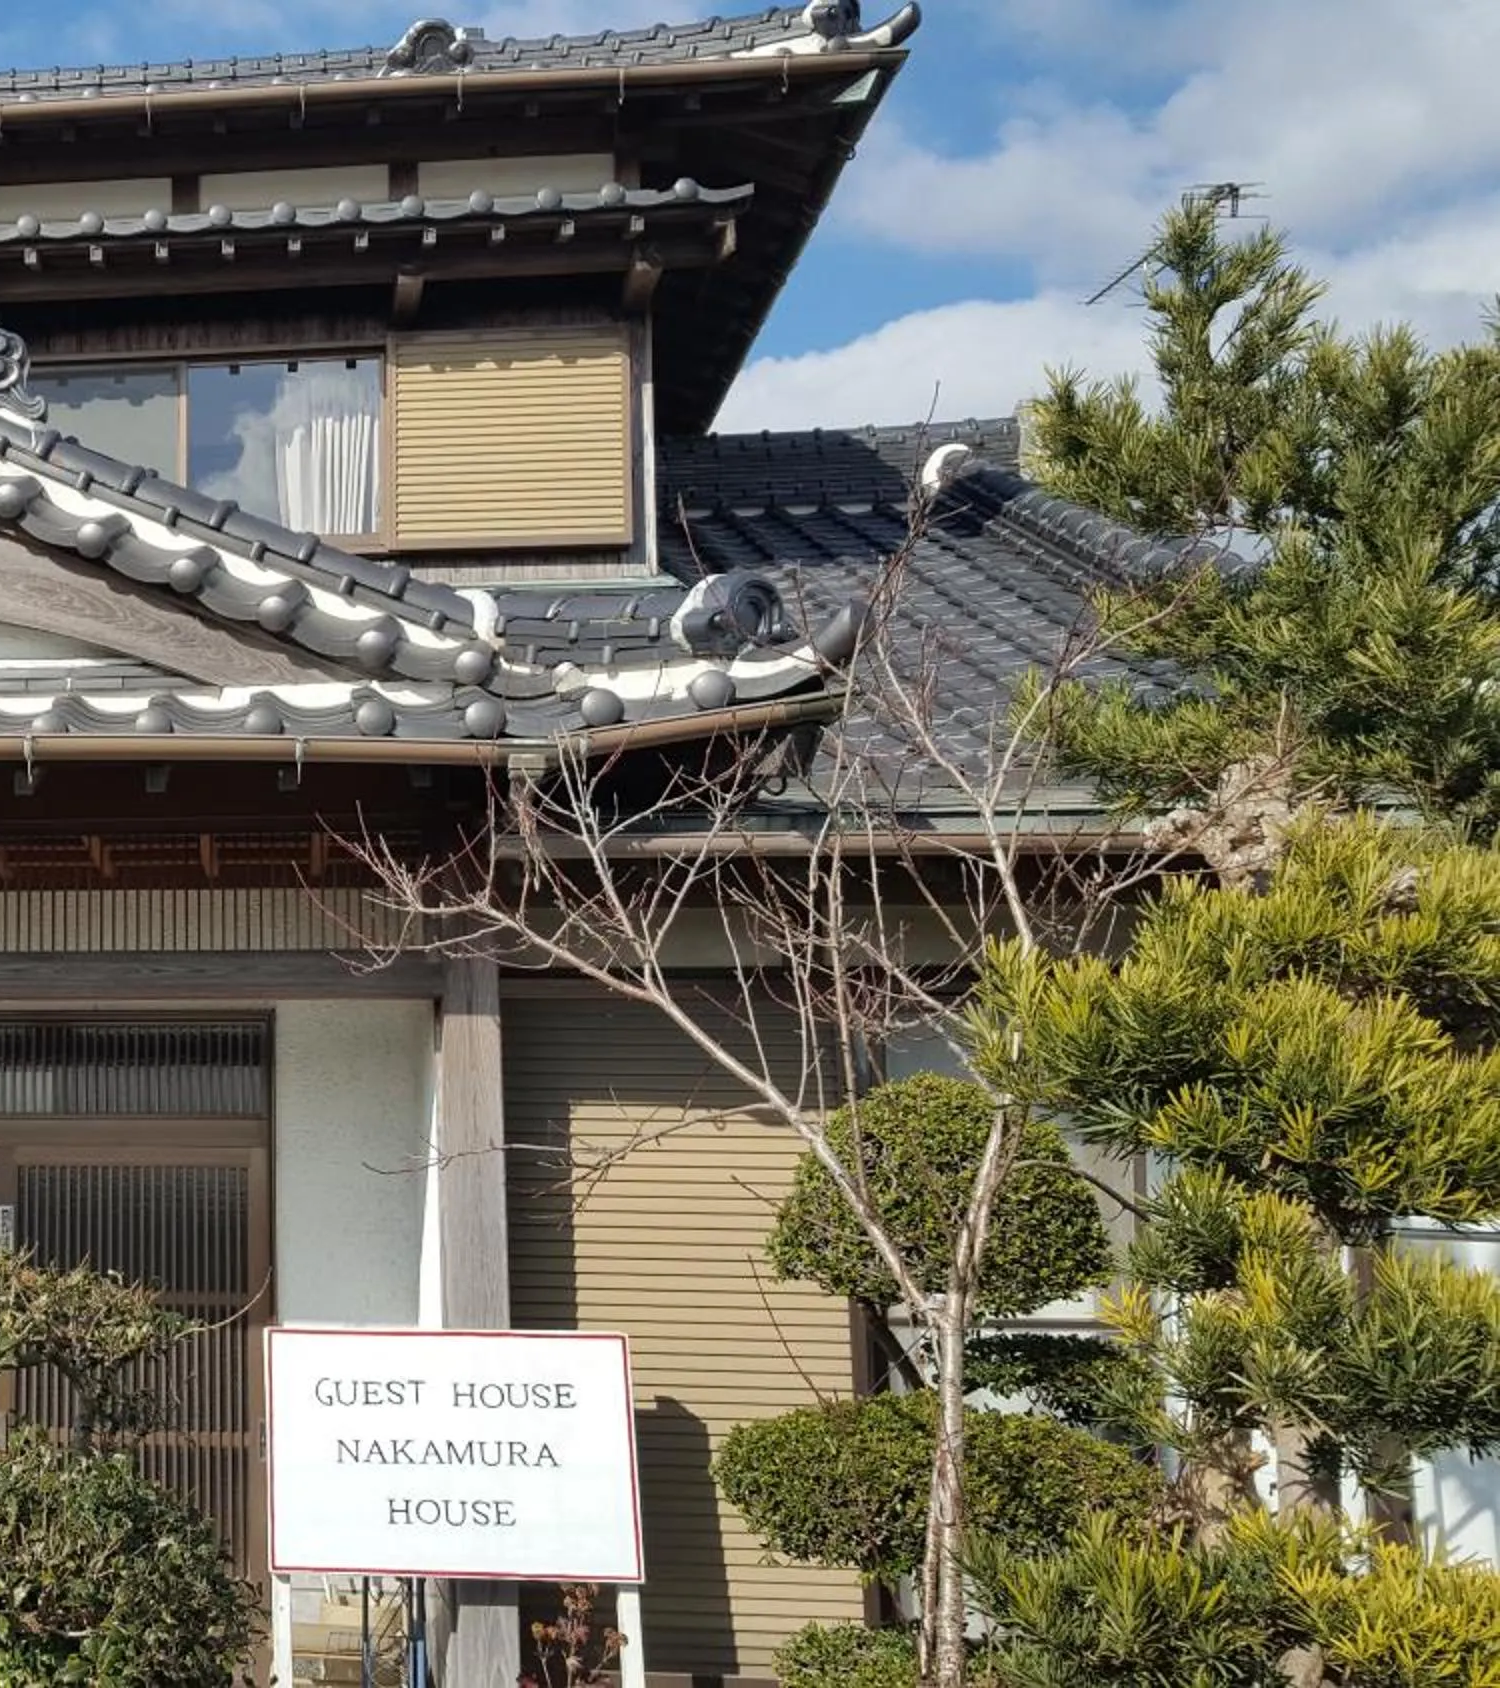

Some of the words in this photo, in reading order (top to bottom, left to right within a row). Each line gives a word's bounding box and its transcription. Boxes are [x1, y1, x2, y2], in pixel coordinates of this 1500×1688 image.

[315, 1377, 426, 1407] GUEST
[453, 1382, 577, 1409] HOUSE
[337, 1439, 560, 1468] NAKAMURA
[388, 1498, 517, 1527] HOUSE
